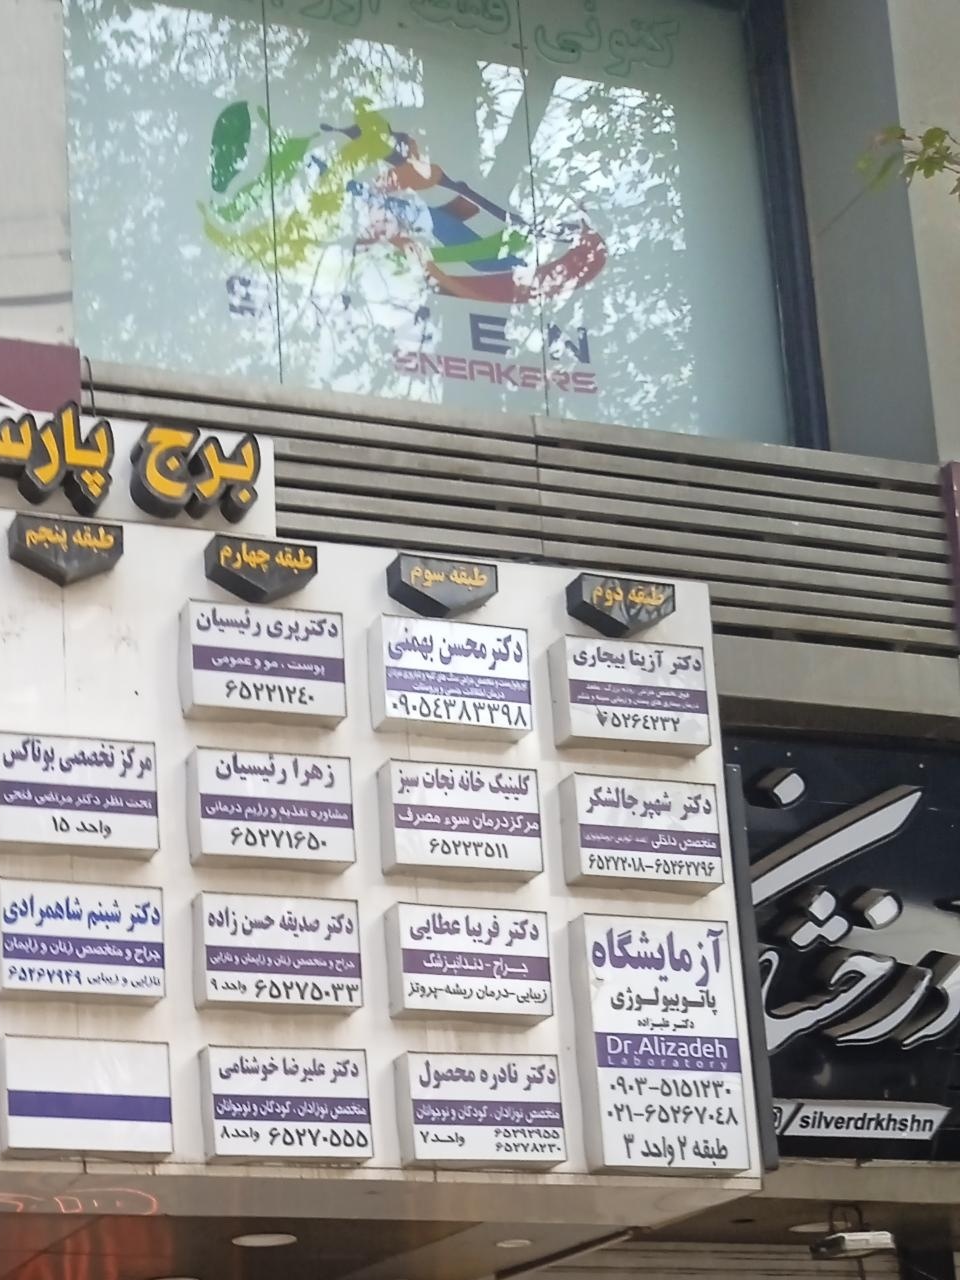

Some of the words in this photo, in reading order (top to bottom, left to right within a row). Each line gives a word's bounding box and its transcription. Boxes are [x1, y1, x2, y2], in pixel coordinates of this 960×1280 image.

[138, 424, 261, 508] برج
[25, 525, 67, 552] پنجم
[73, 527, 114, 552] طبقه
[219, 542, 270, 573] چهارم
[275, 547, 313, 575] طبقه
[410, 565, 445, 587] سوم
[449, 567, 488, 591] طبقه
[592, 585, 623, 607] دوم
[628, 584, 664, 606] طبقه
[196, 608, 261, 636] رئیسیان
[267, 618, 301, 640] پری
[301, 618, 339, 641] دکتر
[388, 627, 433, 662] بهمنی
[439, 638, 487, 665] محسن
[488, 634, 523, 670] دکتر
[573, 646, 625, 669] بیجاری
[264, 662, 278, 671] مو
[630, 649, 663, 673] آزیتا
[669, 656, 701, 675] دکتر
[3, 737, 54, 772] بوتاکس
[59, 743, 114, 772] تخصصی
[119, 747, 152, 778] مرکز
[216, 752, 287, 785] رئیسیان
[293, 758, 335, 788] زهرا
[398, 769, 419, 794] سبز
[423, 768, 454, 796] نجات
[459, 770, 484, 792] خانه
[489, 773, 530, 800] کلینیک
[398, 808, 441, 826] مصرف
[680, 794, 712, 820] دکتر
[51, 815, 70, 832] ۱۵
[76, 820, 112, 839] واحد
[3, 893, 83, 927] شاهمرادی
[87, 899, 121, 930] شبنم
[126, 901, 160, 932] دکتر
[208, 906, 237, 935] زاده
[242, 913, 274, 935] حسن
[279, 911, 320, 937] صدیقه
[324, 914, 353, 940] دکتر
[410, 912, 461, 940] عطایی
[466, 914, 499, 945] فریبا
[505, 919, 539, 946] دکتر
[592, 928, 724, 987] آزمایشگاه
[222, 980, 247, 993] واحد
[606, 1035, 728, 1059] Dr.Alizadeh
[219, 1055, 278, 1082] خوشنامی
[283, 1056, 325, 1082] علیرضا
[329, 1059, 359, 1083] دکتر
[419, 1059, 476, 1089] محصول
[480, 1063, 518, 1090] نادره
[607, 1056, 727, 1070] Laboratory
[523, 1064, 556, 1091] دکتر
[798, 1110, 934, 1135] silverdrkhshn
[431, 1132, 465, 1147] واحد
[641, 1136, 675, 1166] واحد
[678, 1135, 687, 1160] ۲
[692, 1138, 728, 1166] طبقه
